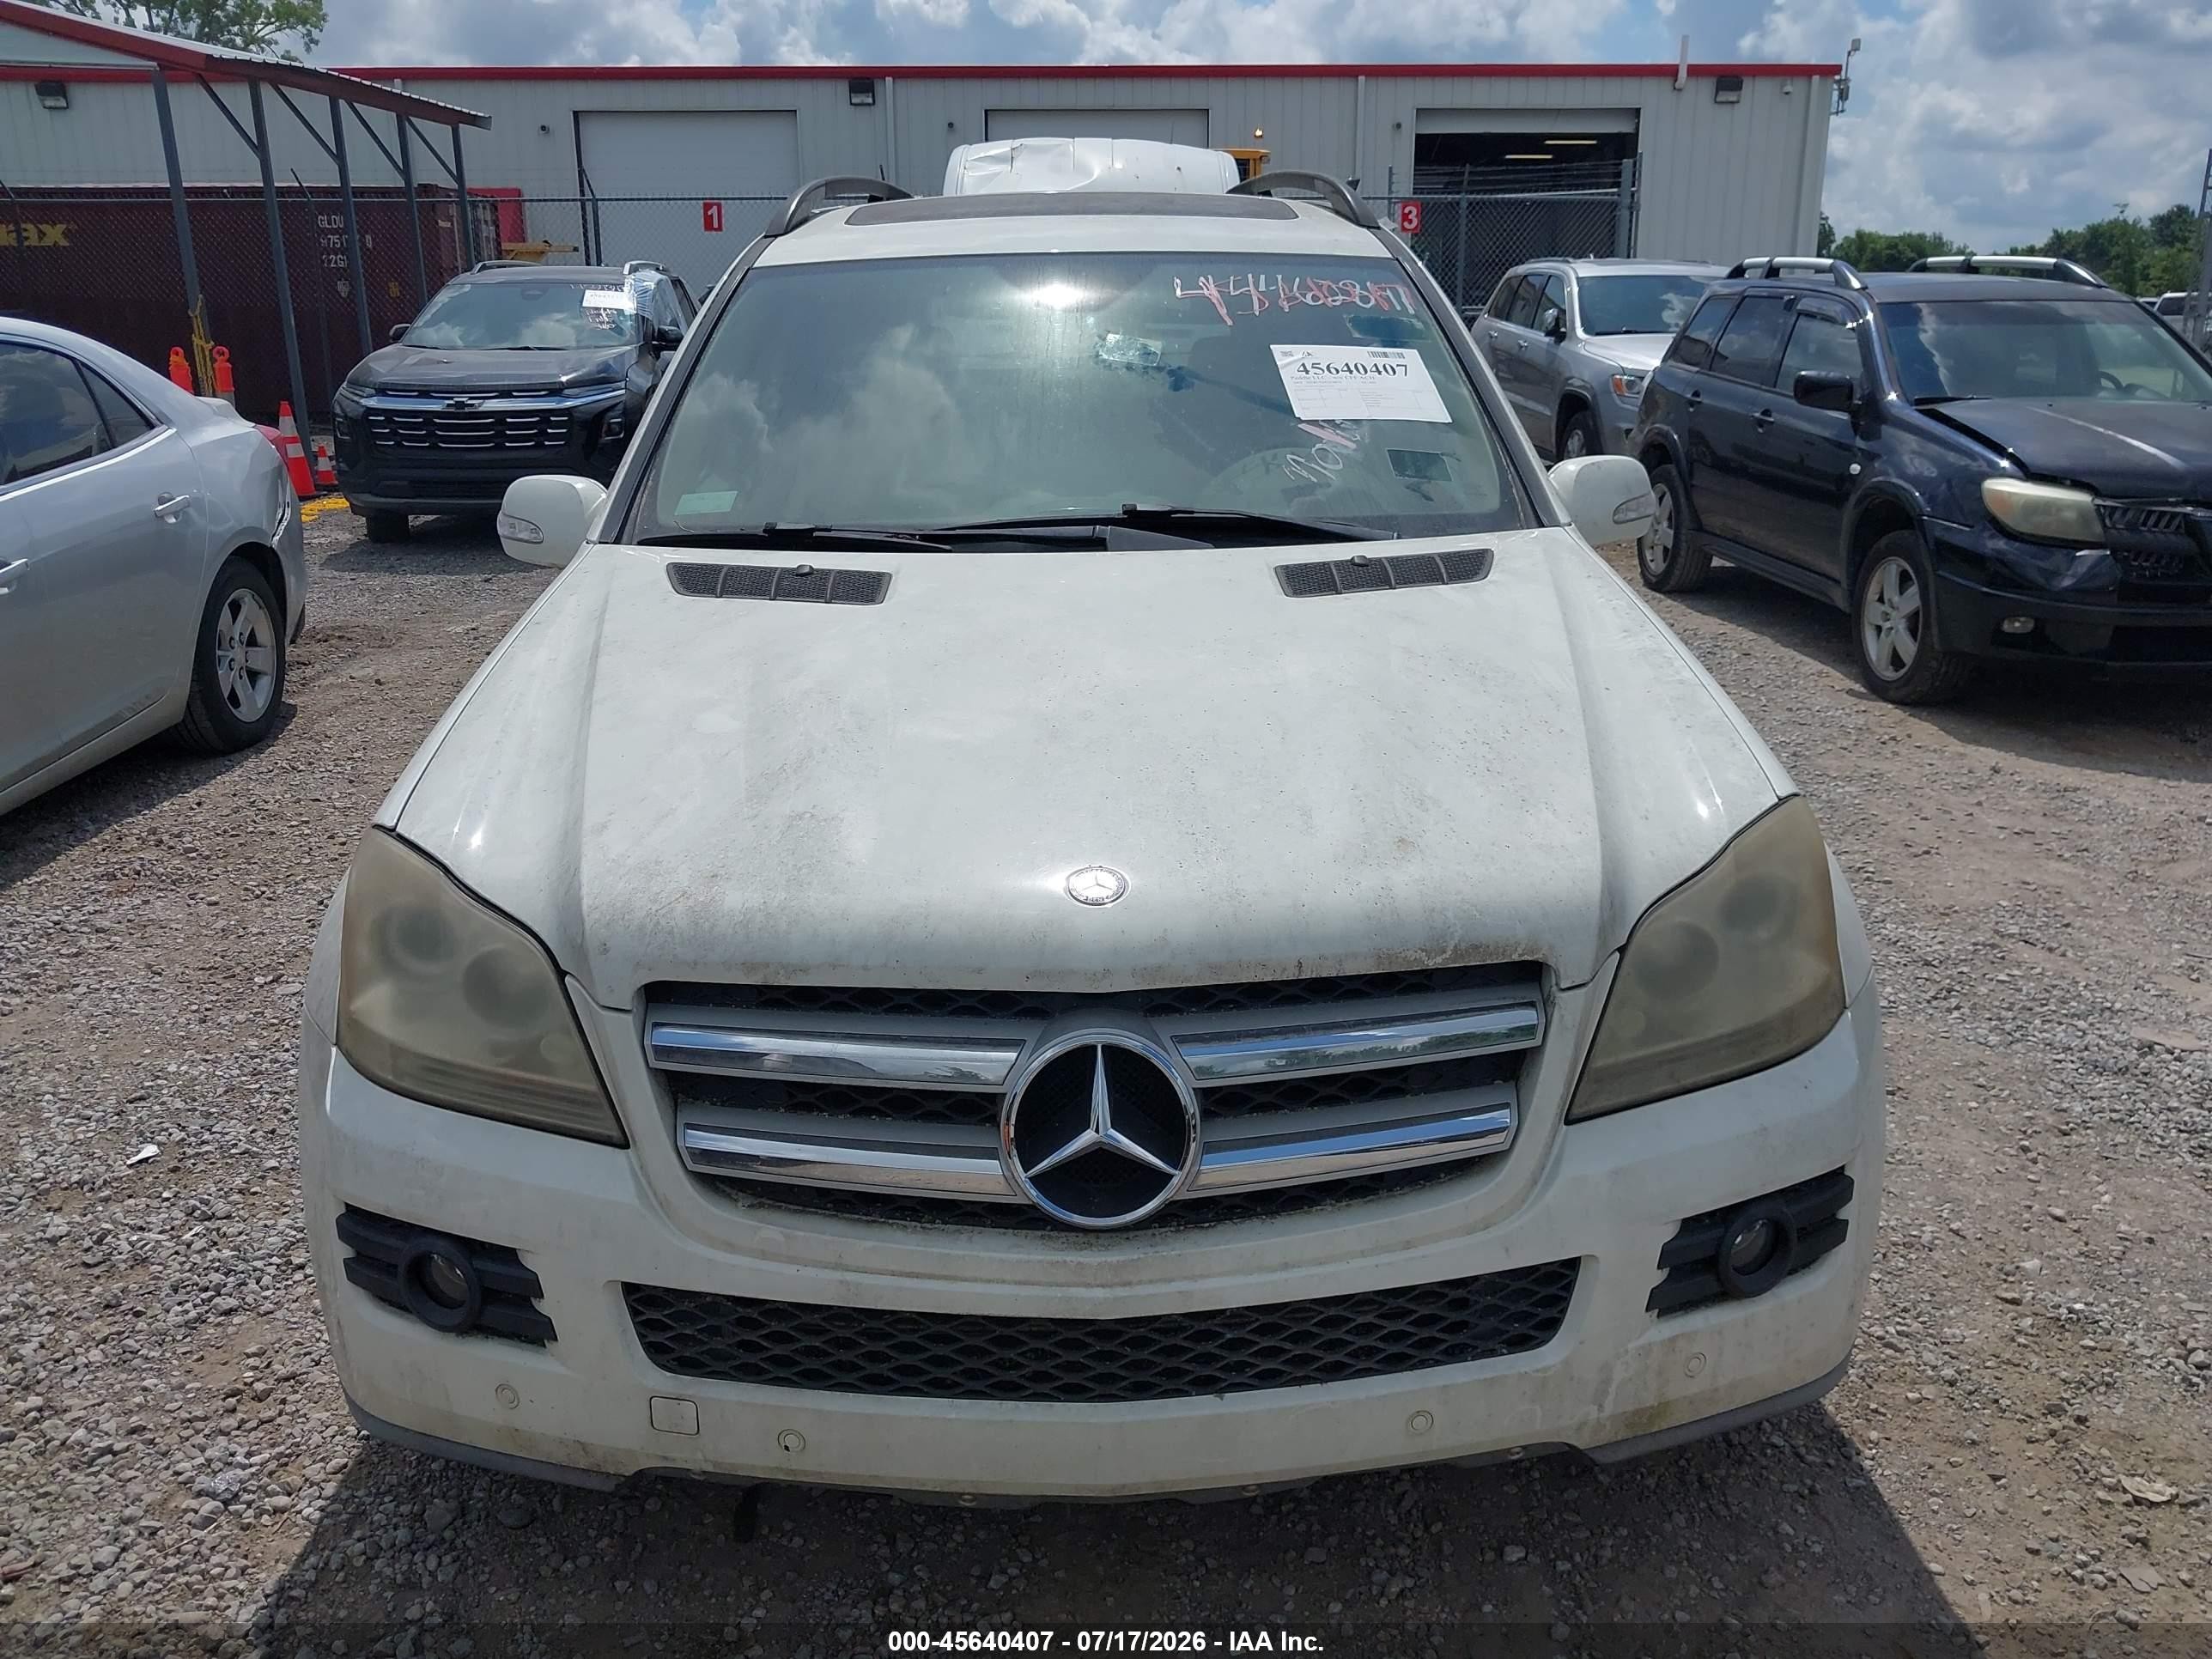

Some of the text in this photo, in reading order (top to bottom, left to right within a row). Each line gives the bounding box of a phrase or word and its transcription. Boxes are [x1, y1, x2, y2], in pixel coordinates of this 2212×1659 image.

[708, 205, 719, 228] 1
[1403, 205, 1418, 229] 3
[1297, 362, 1408, 378] 45640407
